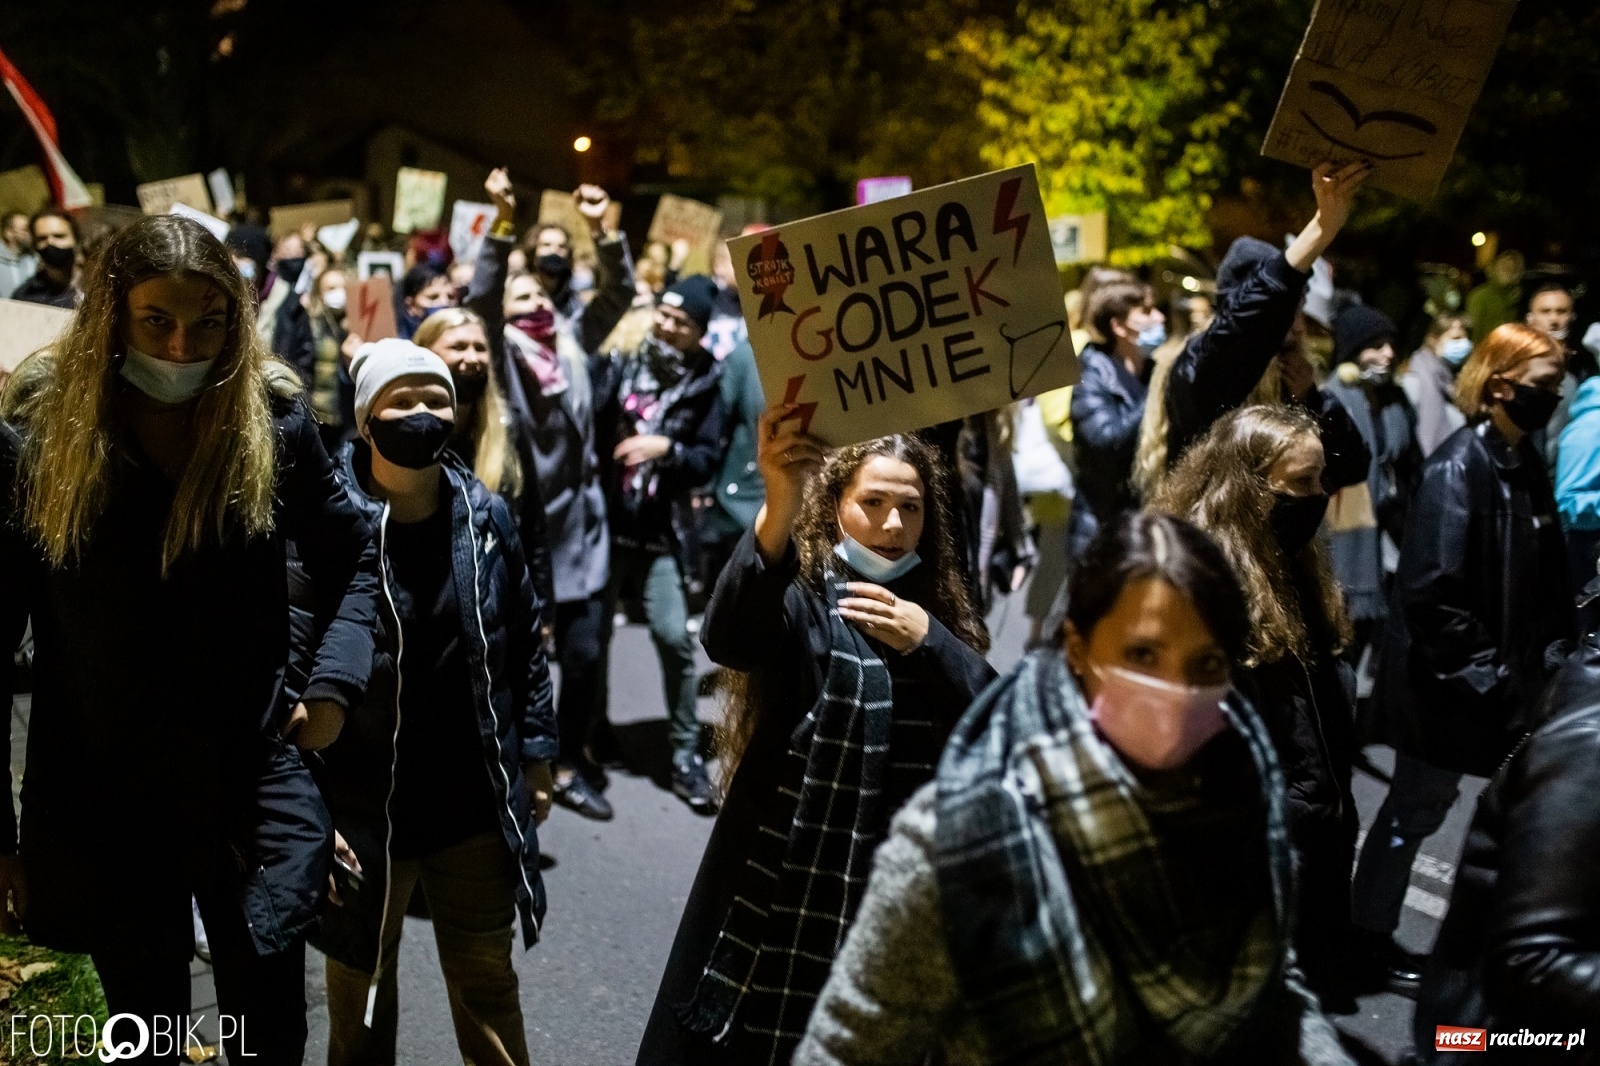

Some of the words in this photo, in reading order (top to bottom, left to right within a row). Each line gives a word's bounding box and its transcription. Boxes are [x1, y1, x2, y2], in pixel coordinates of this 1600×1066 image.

[748, 258, 790, 277] STRAJK
[803, 201, 979, 296] WARA
[790, 257, 1010, 362] GODEK
[832, 330, 991, 412] MNIE
